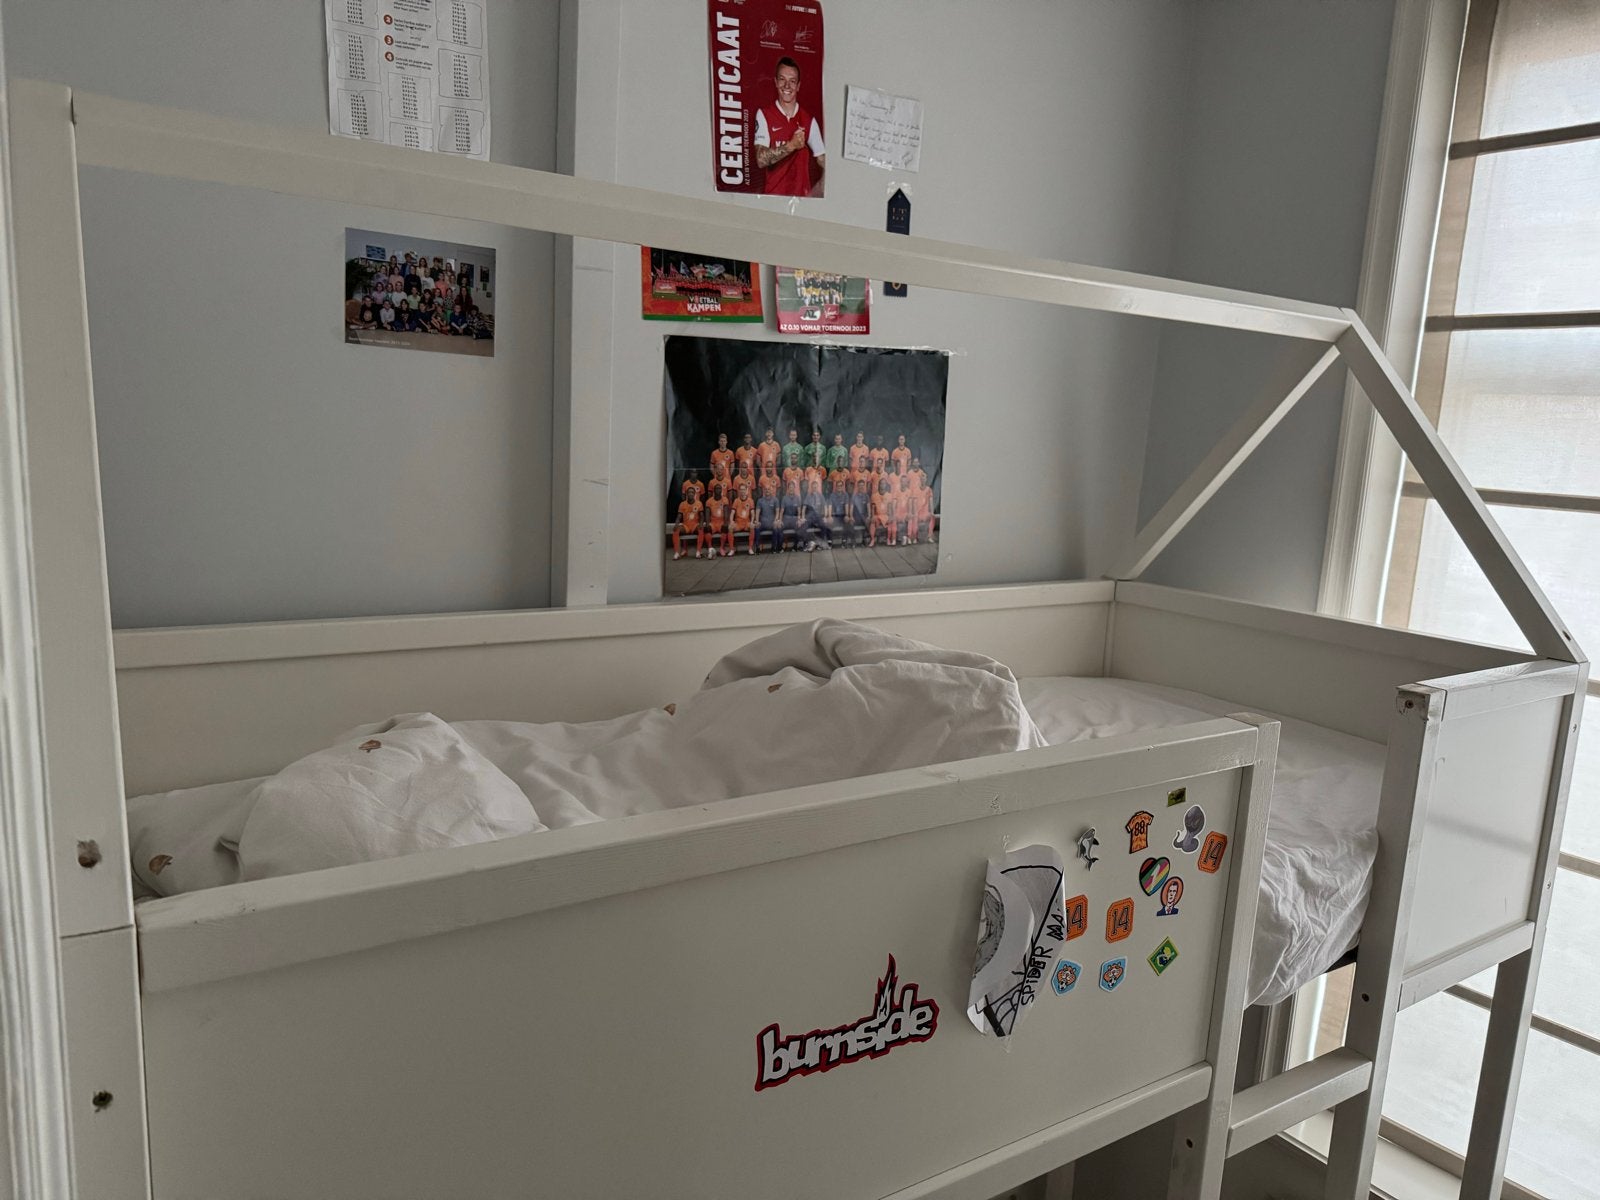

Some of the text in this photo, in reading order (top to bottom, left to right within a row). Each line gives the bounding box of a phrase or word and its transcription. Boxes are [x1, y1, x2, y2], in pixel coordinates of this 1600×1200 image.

[716, 11, 744, 185] CERTIFICAAT
[687, 303, 722, 313] KAMPEN
[803, 309, 818, 319] AZ
[1134, 820, 1146, 836] 88
[1203, 838, 1224, 867] 14
[1111, 905, 1130, 936] 14
[1020, 905, 1066, 1006] SPIDER MA
[757, 968, 938, 1089] burnside
